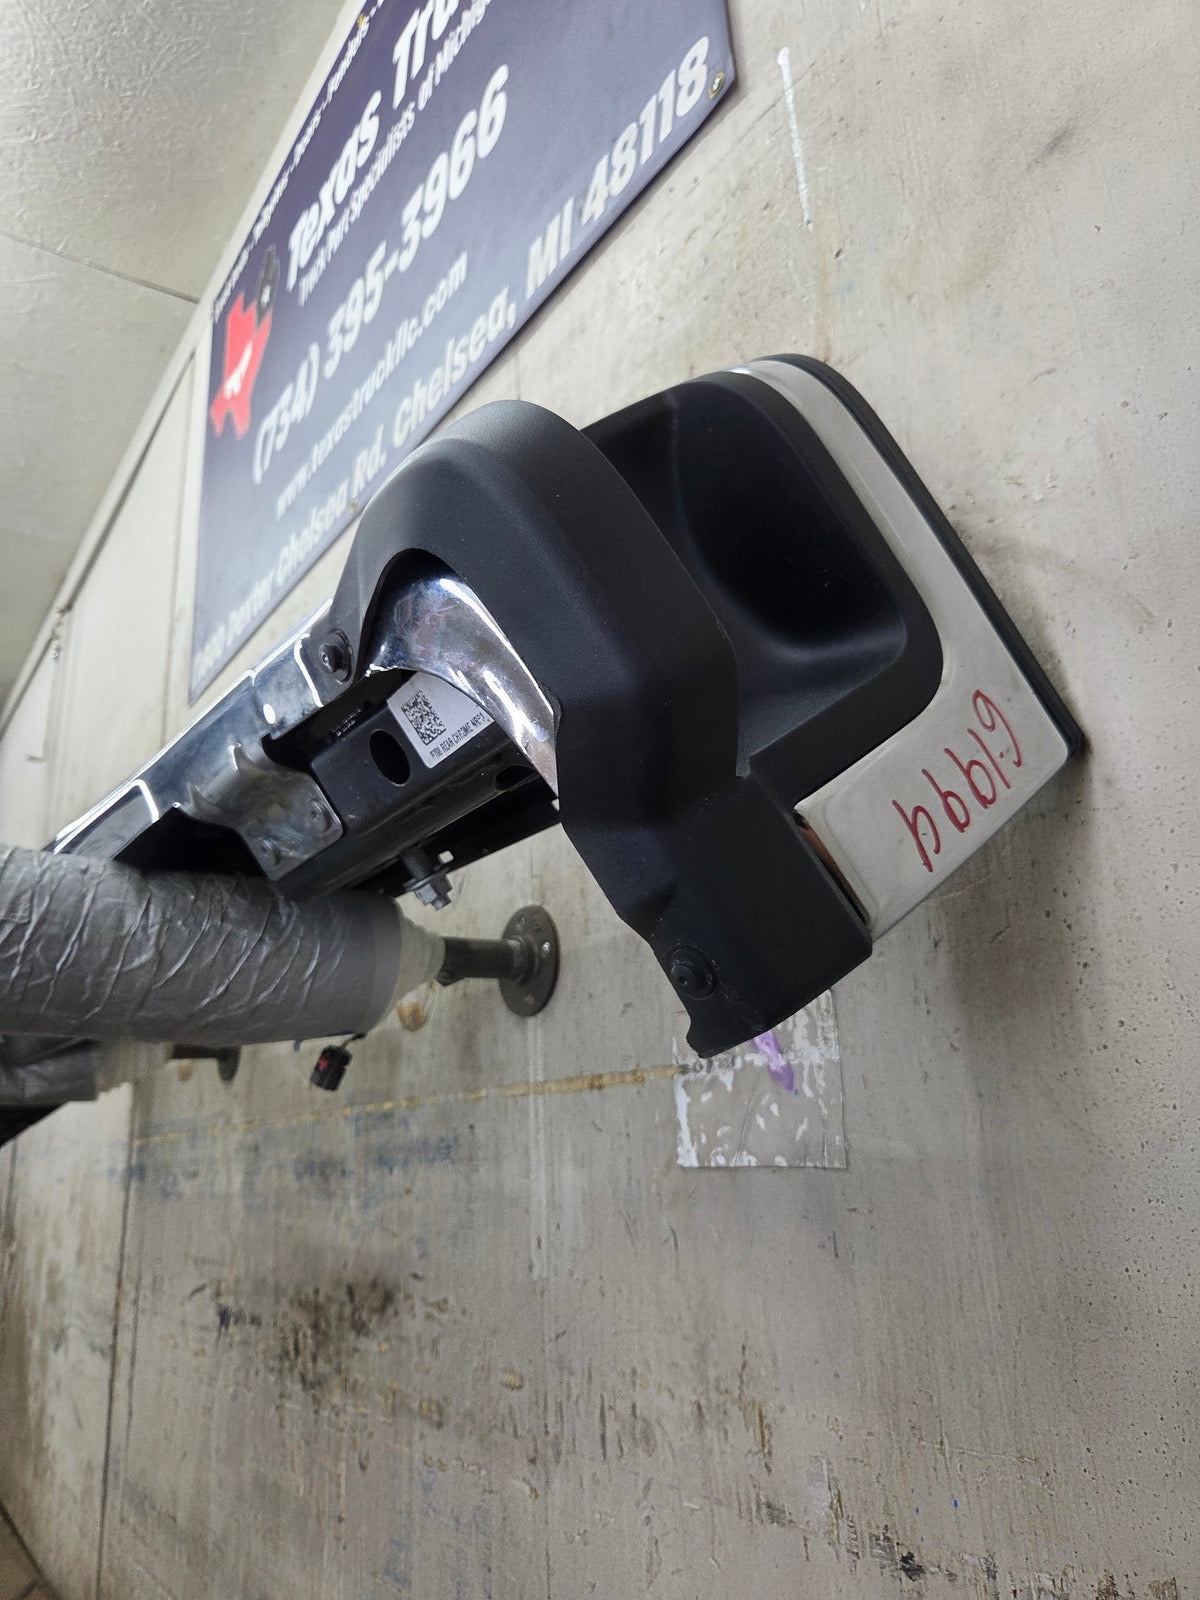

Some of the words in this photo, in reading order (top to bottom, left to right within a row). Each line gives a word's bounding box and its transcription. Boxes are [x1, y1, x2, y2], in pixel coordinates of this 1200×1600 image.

[253, 343, 319, 484] (734)
[324, 65, 509, 380] 395-3966
[286, 90, 382, 292] Texas
[298, 246, 327, 307] Truck
[326, 206, 350, 264] Part
[349, 101, 416, 224] Specialists
[418, 62, 435, 110] of
[434, 0, 491, 87] Michig
[276, 497, 348, 587] Chelsea
[351, 436, 386, 494] Rd.
[393, 286, 517, 447] Chelsea,
[526, 197, 573, 301] MI
[581, 36, 710, 226] 48118
[276, 251, 468, 520] www.texastruckllc.com
